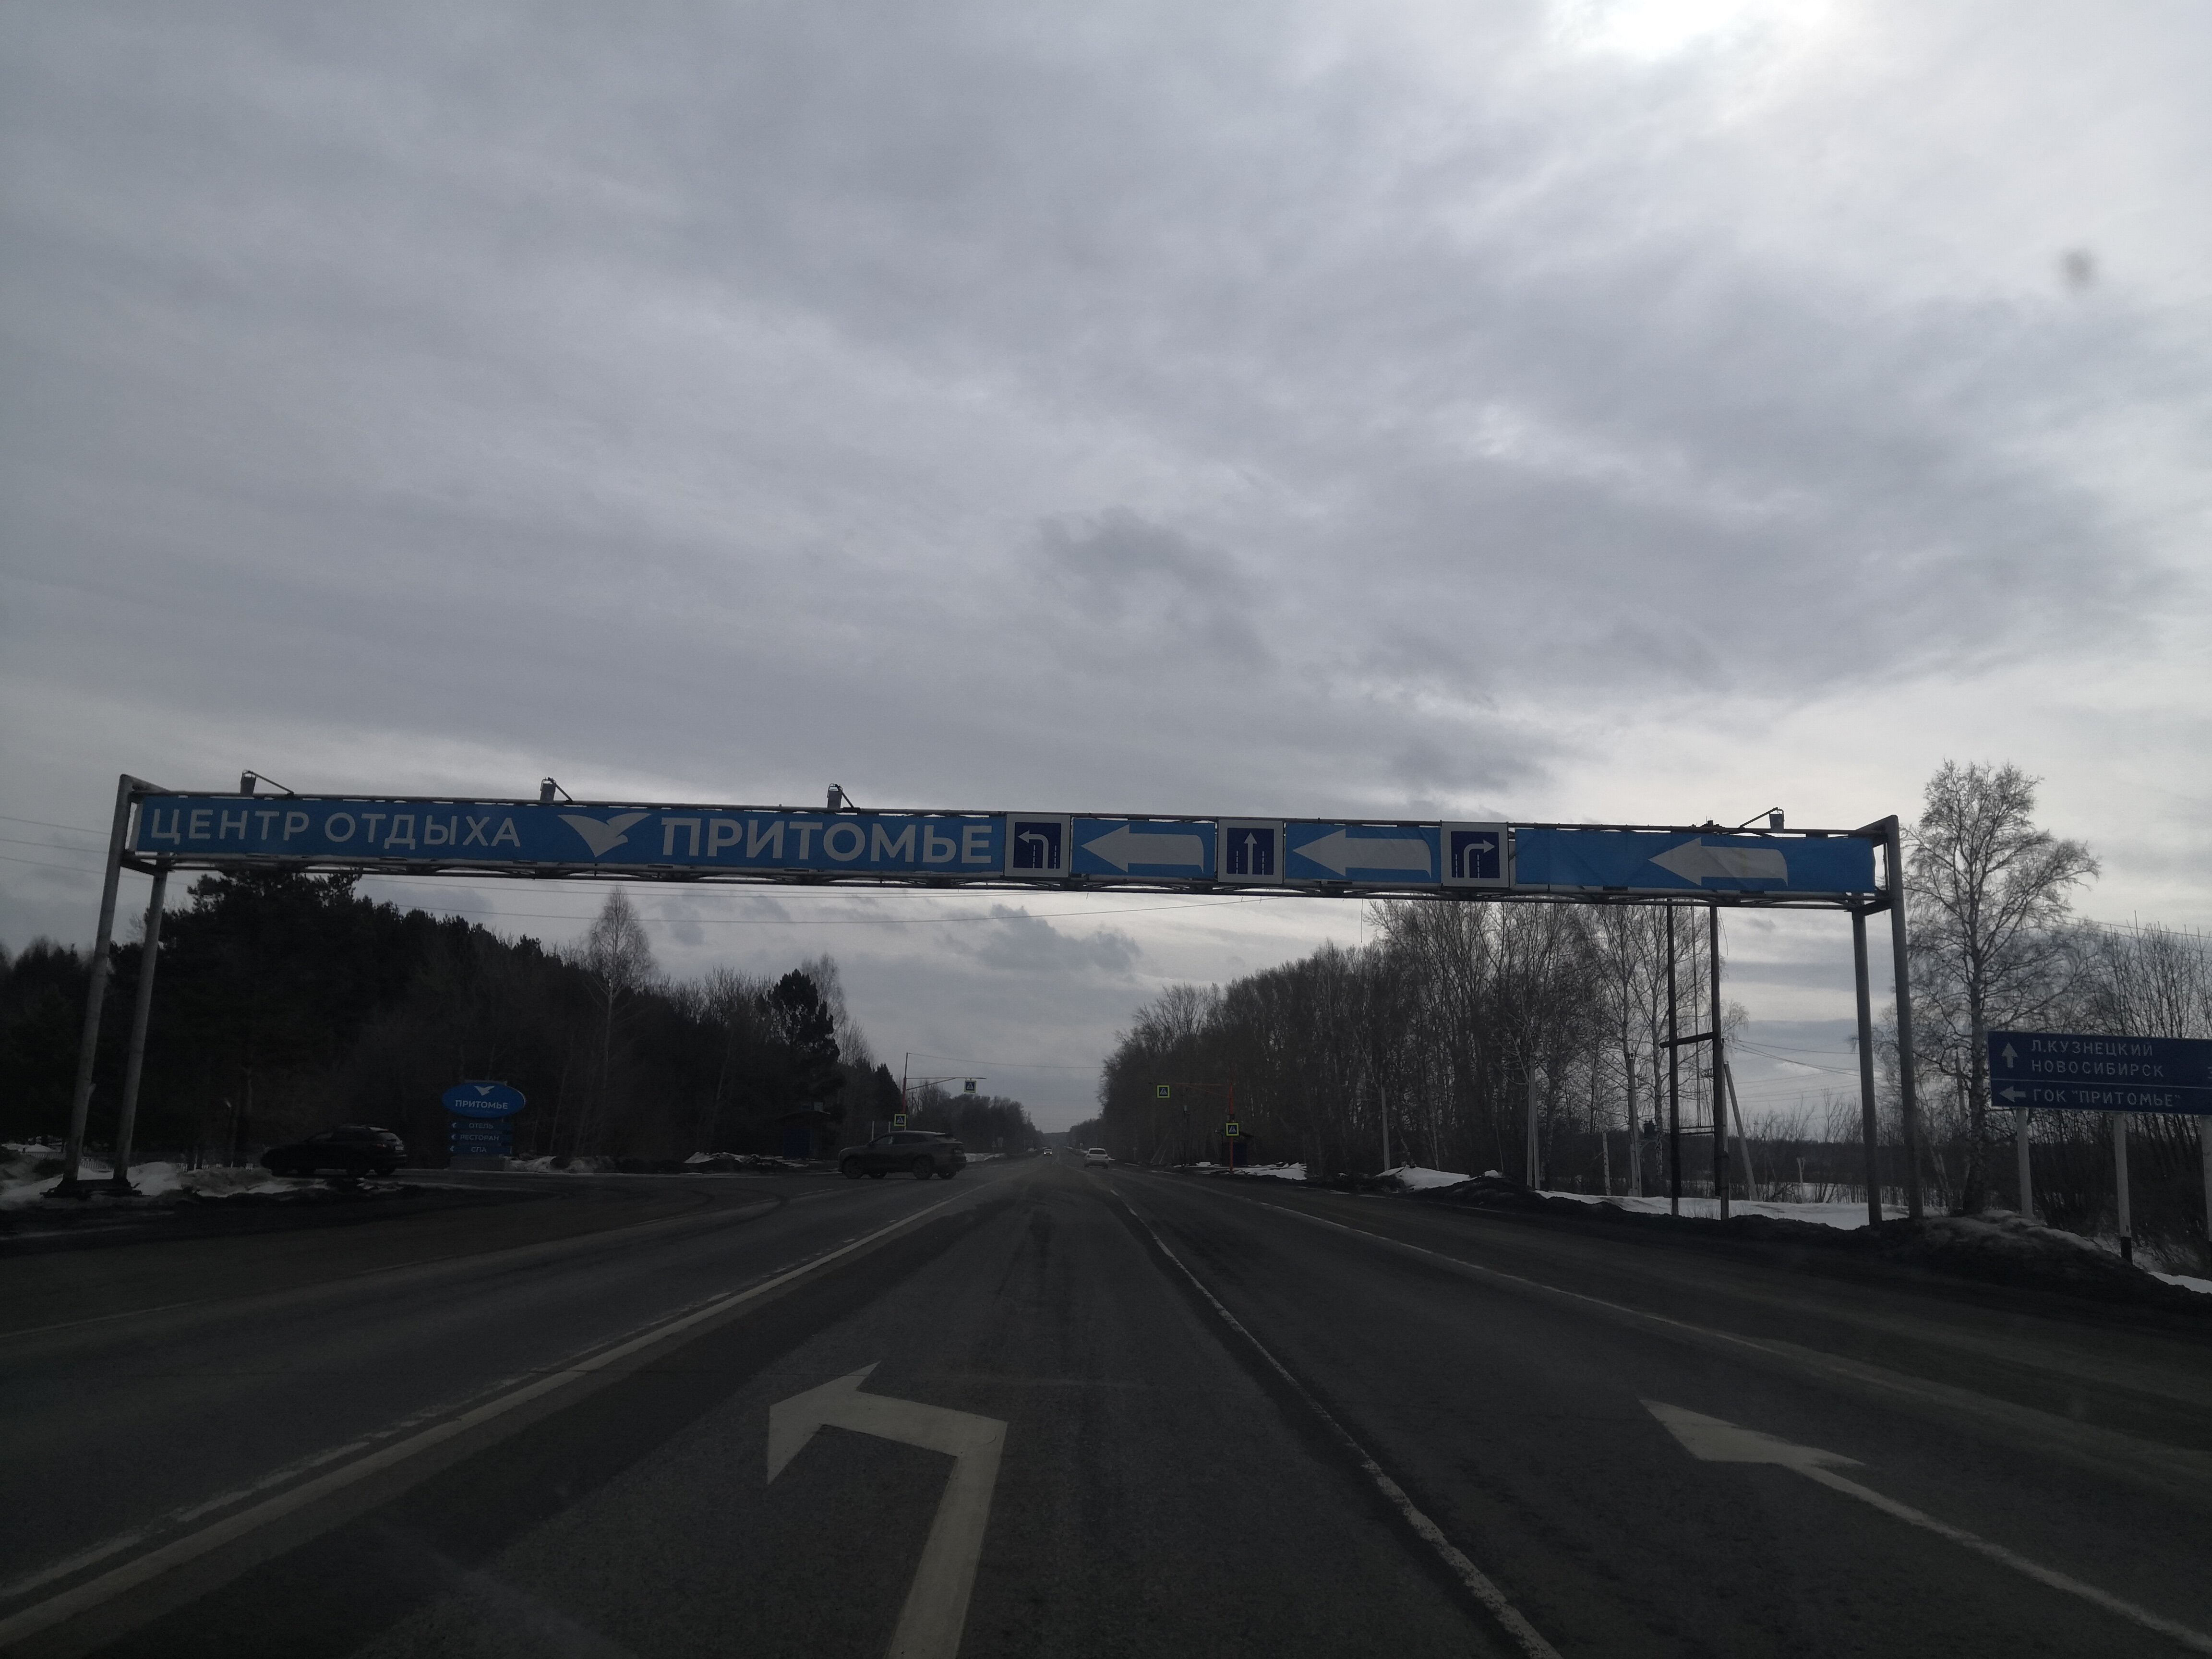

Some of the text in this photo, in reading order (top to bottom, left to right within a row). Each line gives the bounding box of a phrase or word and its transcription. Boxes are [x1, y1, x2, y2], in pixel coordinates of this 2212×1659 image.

[151, 808, 992, 864] ЦЕНТР ОТДЫХА ПРИТОМЬЕ
[2031, 1039, 2153, 1057] Л.КУЗНЕЦКИЙ
[2032, 1059, 2164, 1077] НОВОСИБИРСК
[455, 1099, 508, 1109] ПРИТОМЬЕ
[2033, 1089, 2067, 1102] ГОК
